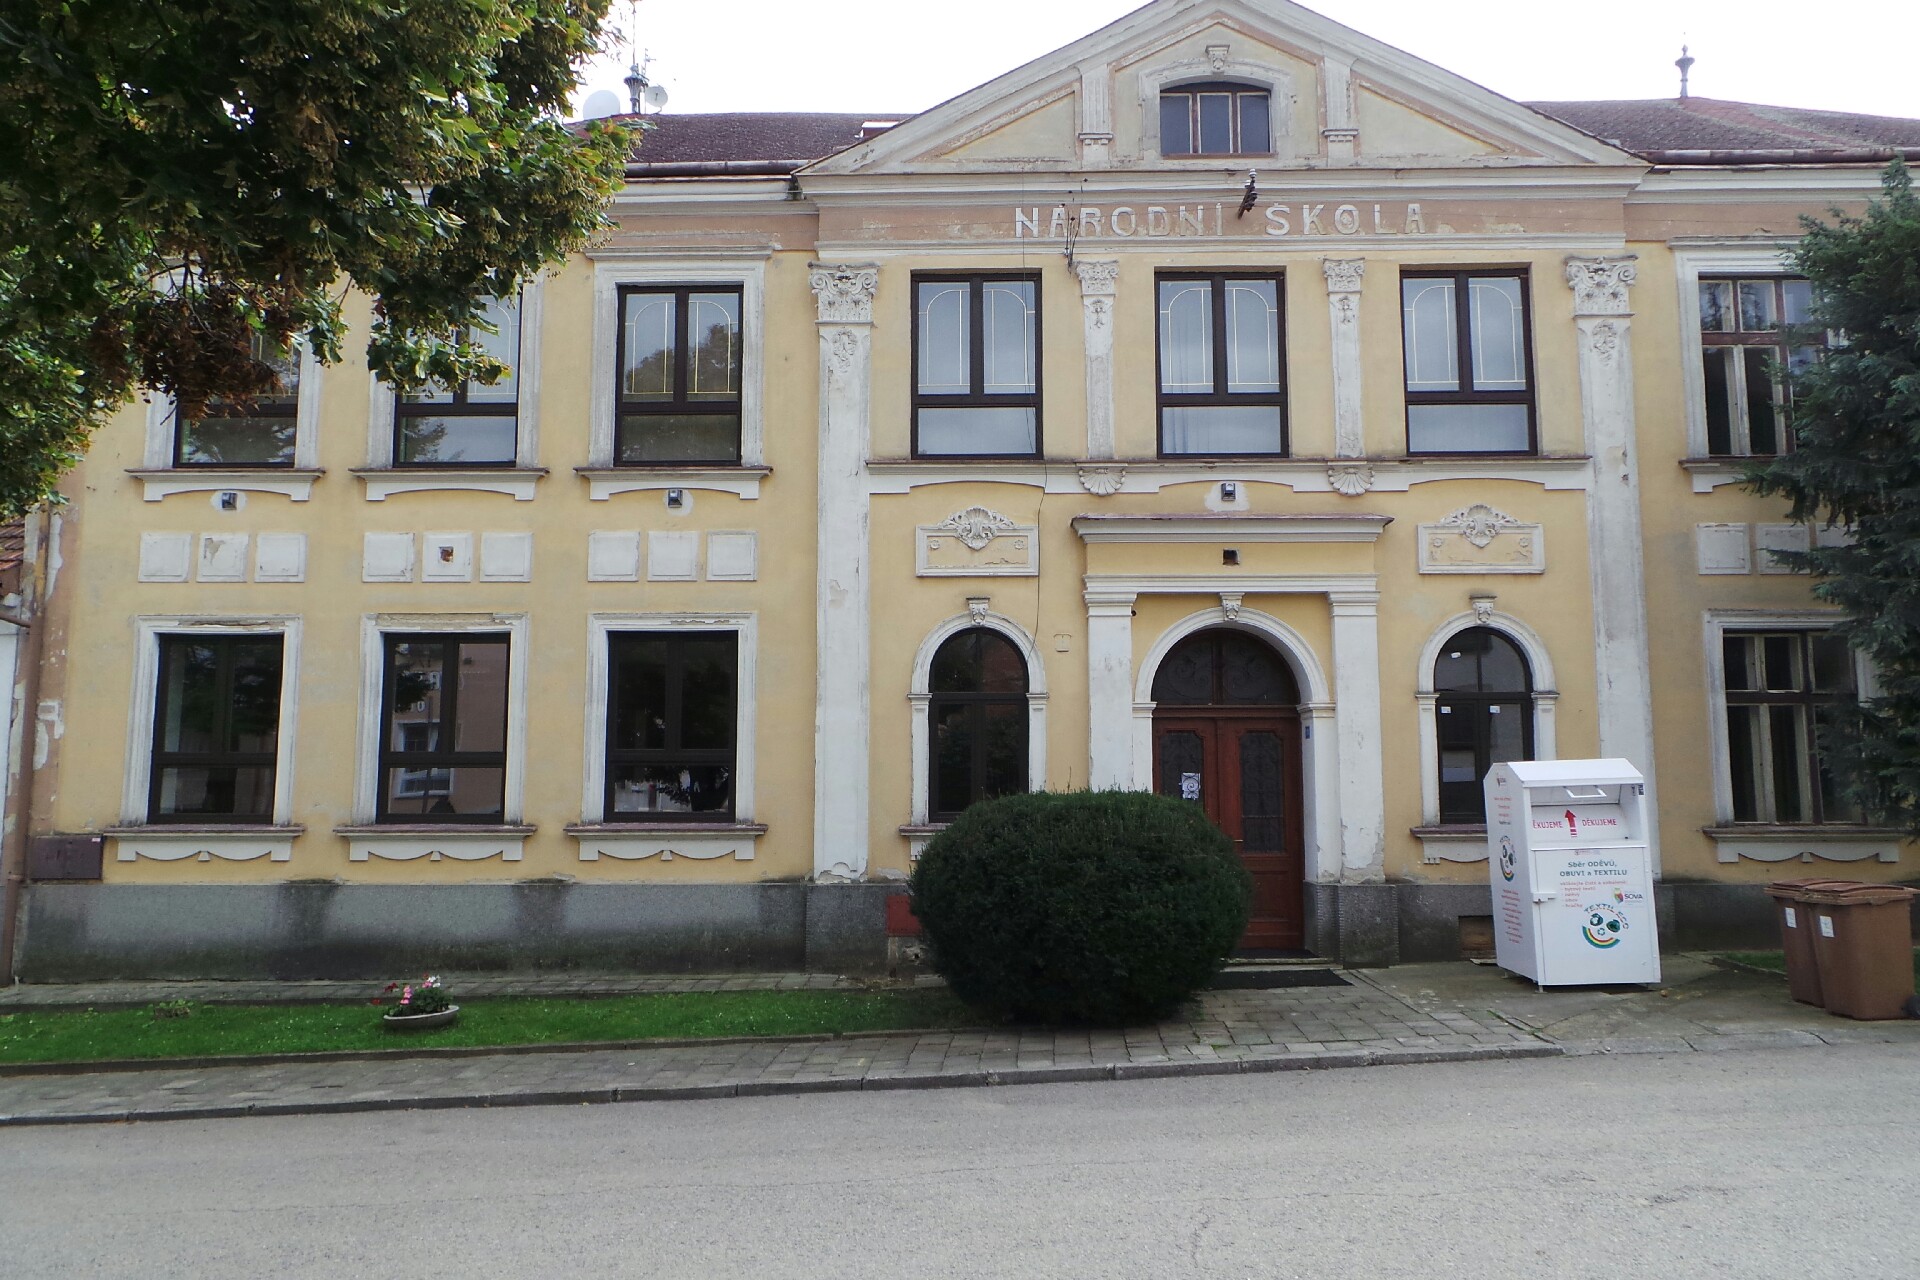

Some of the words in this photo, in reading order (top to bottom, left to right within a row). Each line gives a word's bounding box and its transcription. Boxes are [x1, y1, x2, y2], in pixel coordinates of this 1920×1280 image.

[1265, 203, 1426, 236] ŠKOLA
[1532, 819, 1563, 829] ĚKUJEME
[1582, 817, 1617, 827] DĚKUJEME
